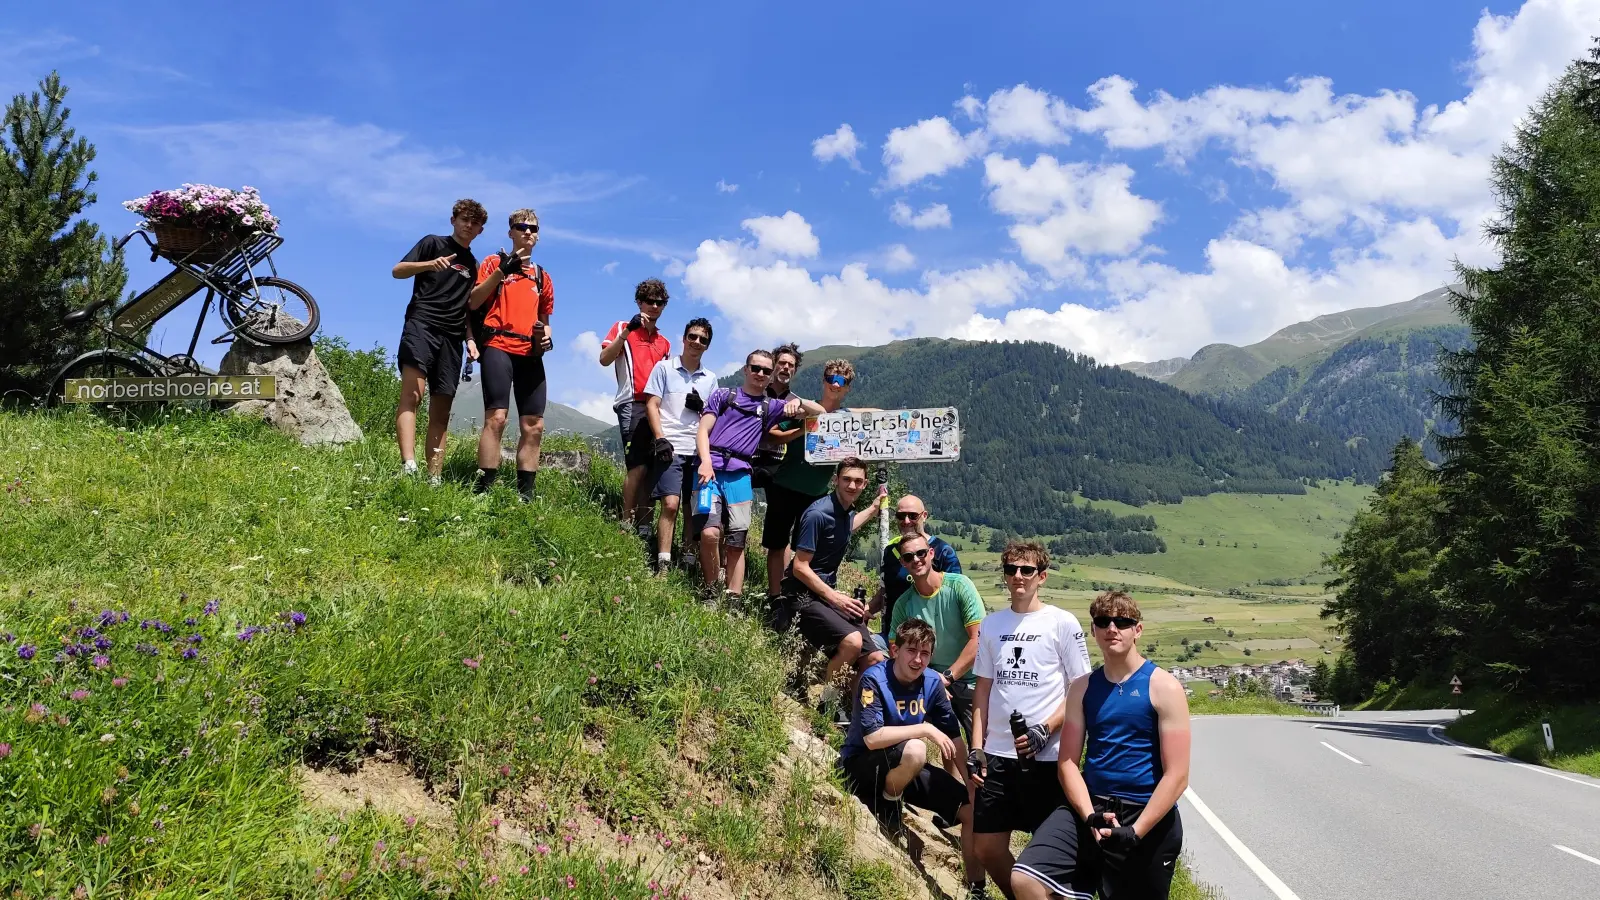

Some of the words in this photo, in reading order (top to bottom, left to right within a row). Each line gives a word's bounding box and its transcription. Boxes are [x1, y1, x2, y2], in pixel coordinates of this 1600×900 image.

[120, 289, 183, 333] Norbertshöhe
[77, 378, 261, 399] norbertshoehe.at
[822, 412, 942, 433] orbertshhe
[996, 670, 1039, 681] MEISTER
